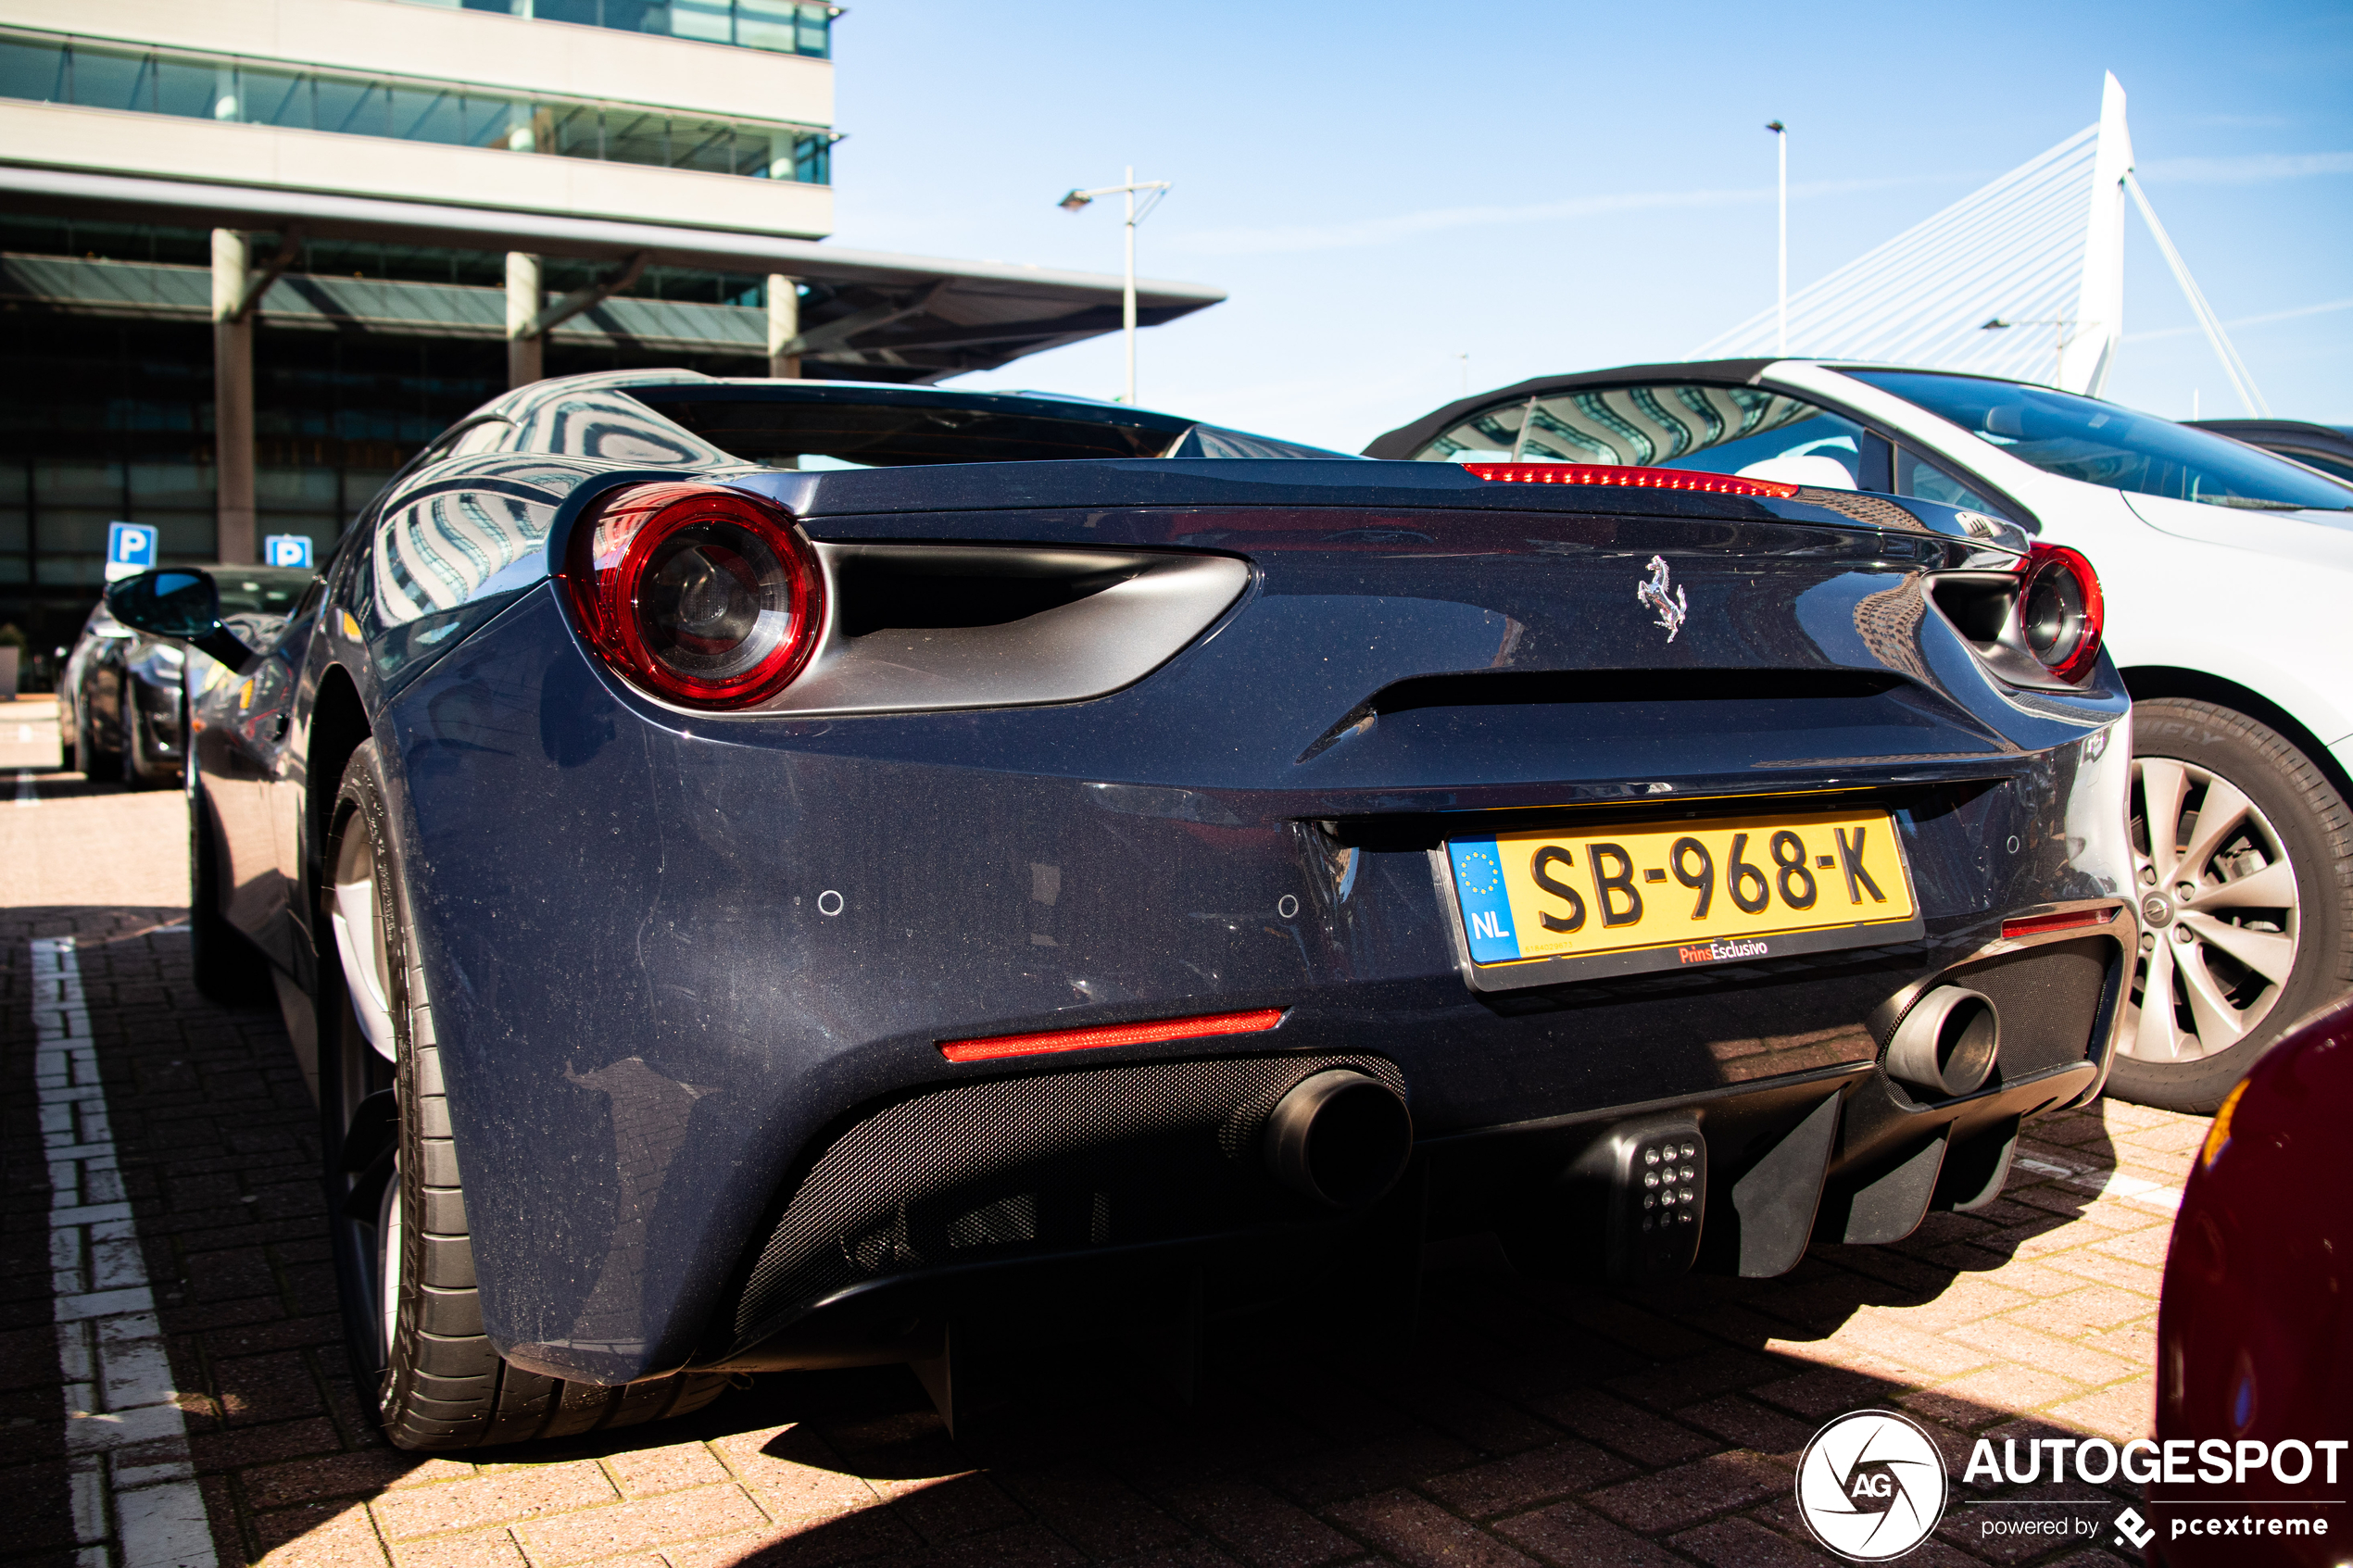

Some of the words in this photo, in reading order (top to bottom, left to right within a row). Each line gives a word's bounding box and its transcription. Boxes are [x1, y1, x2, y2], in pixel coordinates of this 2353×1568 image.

[119, 530, 147, 561] P
[277, 542, 304, 567] P
[1530, 827, 1887, 934] SB-968-K
[1471, 910, 1510, 940] NL
